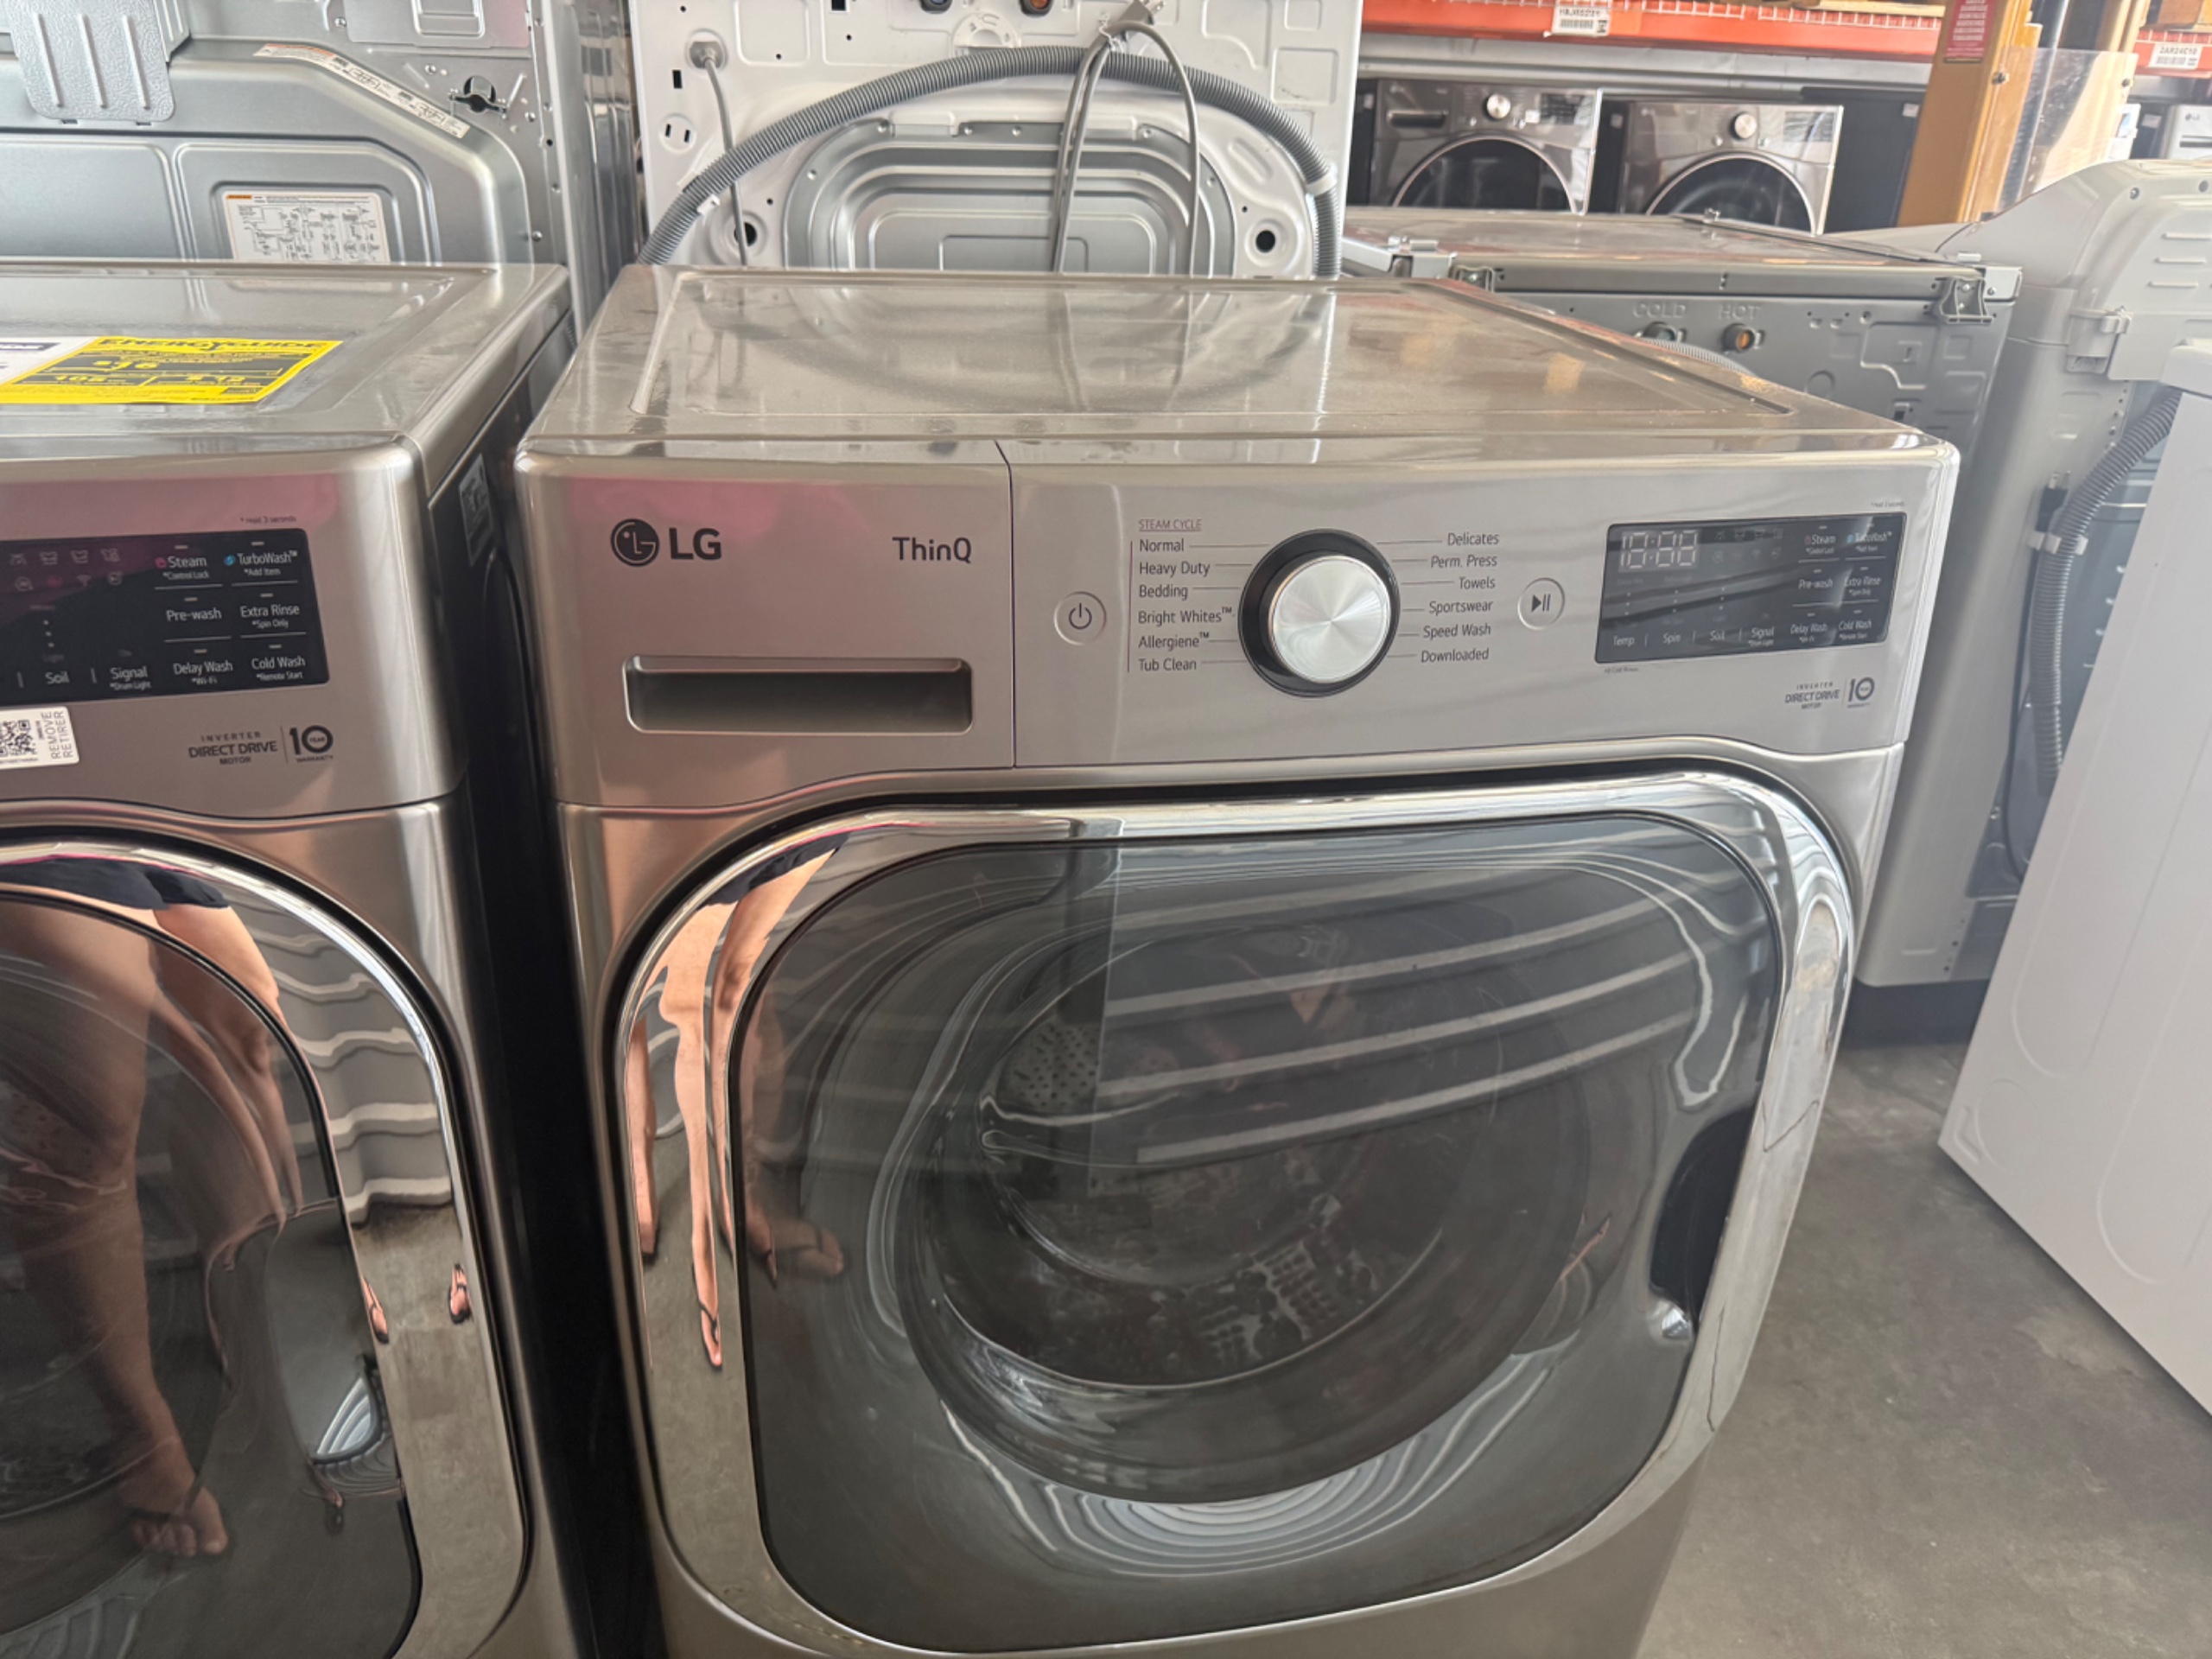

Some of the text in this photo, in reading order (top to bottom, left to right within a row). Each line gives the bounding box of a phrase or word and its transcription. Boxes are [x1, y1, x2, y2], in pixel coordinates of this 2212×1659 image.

[1632, 302, 1686, 318] COLD
[1717, 302, 1760, 320] HOT
[1139, 518, 1202, 529] STEAM CYCLE
[668, 527, 722, 561] LG
[1139, 537, 1185, 552] Normal
[1447, 531, 1499, 546] Delicates
[892, 536, 972, 563] ThinQ
[167, 555, 207, 569] Steam
[1431, 554, 1497, 568] Perm. Press
[1139, 561, 1211, 578] Heavy Duty
[1459, 575, 1496, 589] Towels
[1139, 583, 1189, 601] Bedding
[166, 607, 222, 621] Pre-wash
[239, 604, 300, 619] Extra Rinse
[1428, 601, 1494, 616] Sportswear
[1138, 610, 1176, 627] Bright
[1423, 622, 1491, 640] Speed Wash
[1662, 632, 1681, 645] Spin
[1709, 630, 1726, 641] Soil
[1751, 626, 1774, 639] Signal
[1613, 635, 1635, 647] Temp
[1421, 647, 1490, 663] Downloaded
[173, 660, 233, 676] Delay Wash
[251, 656, 306, 671] Cold Wash
[1138, 658, 1197, 671] Tub Clean
[45, 671, 70, 684] Soil
[110, 666, 148, 681] Signal
[1785, 690, 1840, 703] DIRECT DRIVE
[1848, 677, 1875, 702] 10
[41, 711, 61, 759] REMOVE
[54, 710, 73, 758] RETIRER
[201, 731, 261, 742] INVERTER
[289, 725, 334, 755] 10
[188, 741, 278, 759] DIRECT DRIVE
[219, 756, 251, 765] MOTOR
